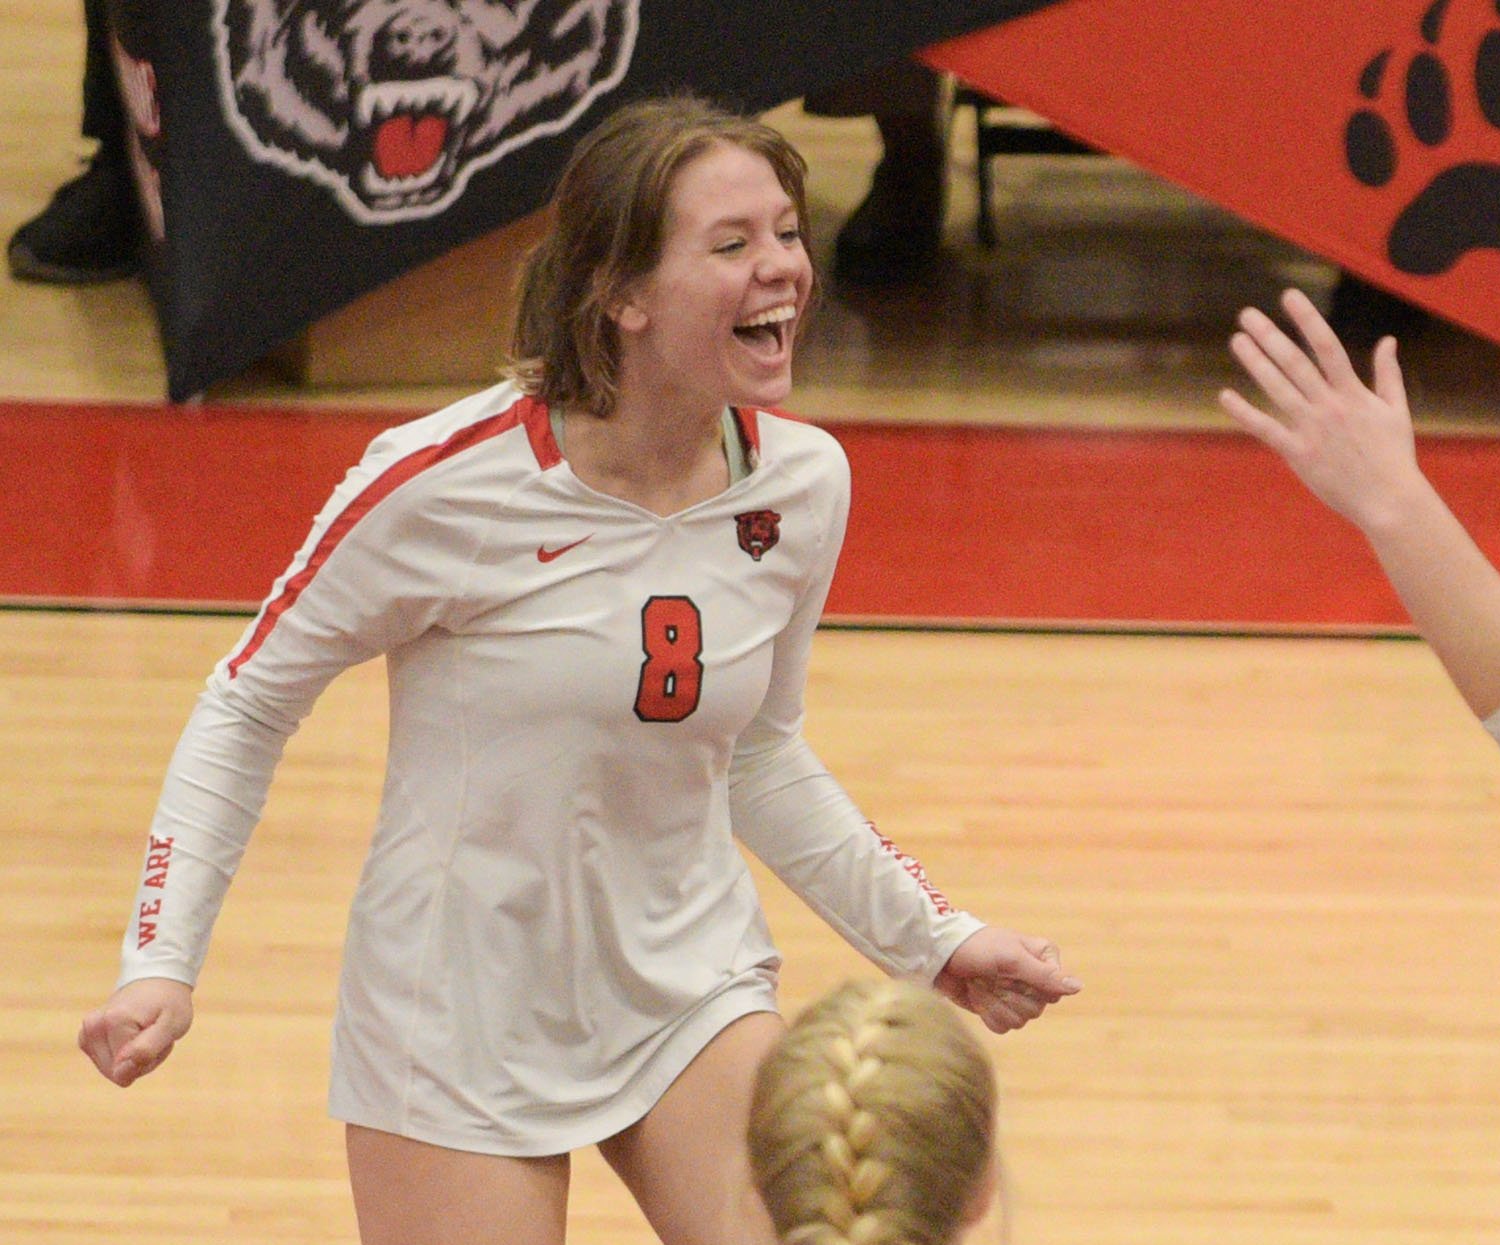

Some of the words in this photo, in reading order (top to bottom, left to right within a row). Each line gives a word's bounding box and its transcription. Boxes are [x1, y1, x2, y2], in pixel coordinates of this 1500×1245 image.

[633, 595, 704, 723] 8
[144, 834, 175, 889] ARE
[137, 899, 162, 950] WE
